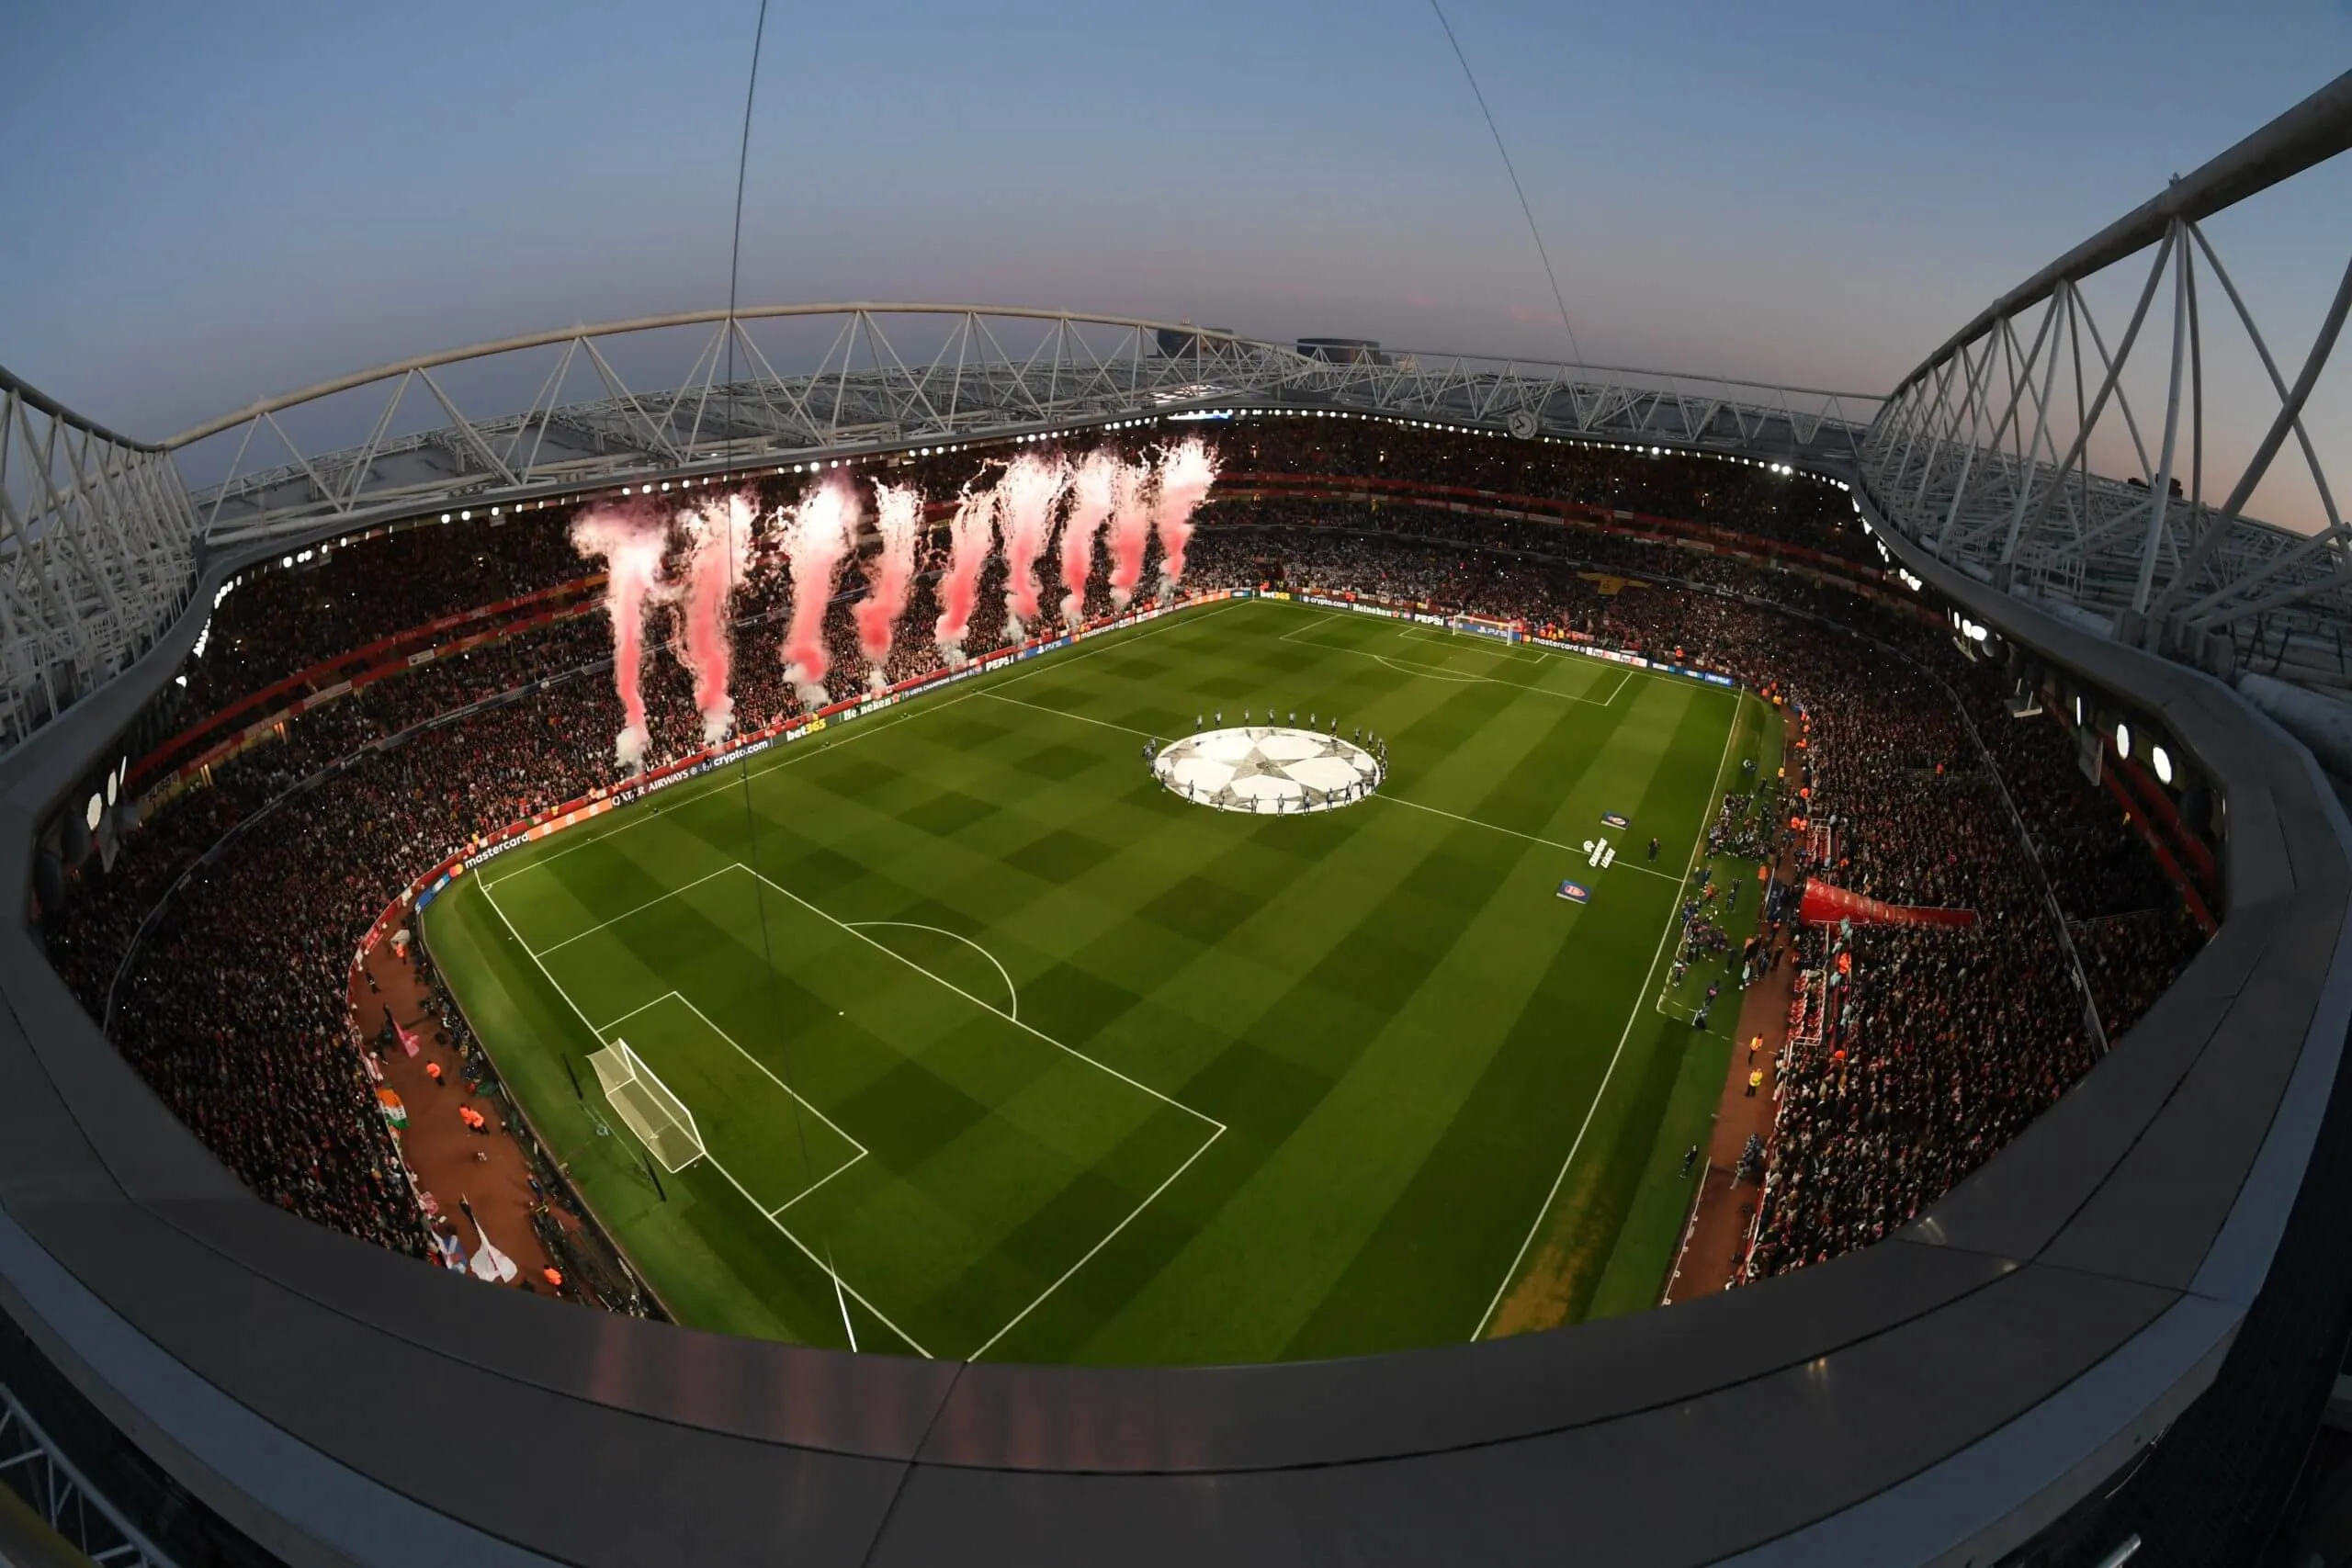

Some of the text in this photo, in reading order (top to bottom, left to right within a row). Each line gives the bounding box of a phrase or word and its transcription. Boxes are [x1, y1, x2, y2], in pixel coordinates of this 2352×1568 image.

[1260, 591, 1290, 601] bet365
[1310, 598, 1348, 608] crypto.com
[1352, 603, 1392, 617] Heineken
[1415, 614, 1443, 626] PEPSI
[1532, 637, 1579, 651] mastercard
[985, 653, 1014, 672] PEPSI
[843, 697, 891, 721] Heneken
[786, 718, 827, 742] bet365
[713, 740, 768, 767] crypto.com
[648, 770, 688, 793] AIRWAYS
[465, 831, 529, 869] mastercard
